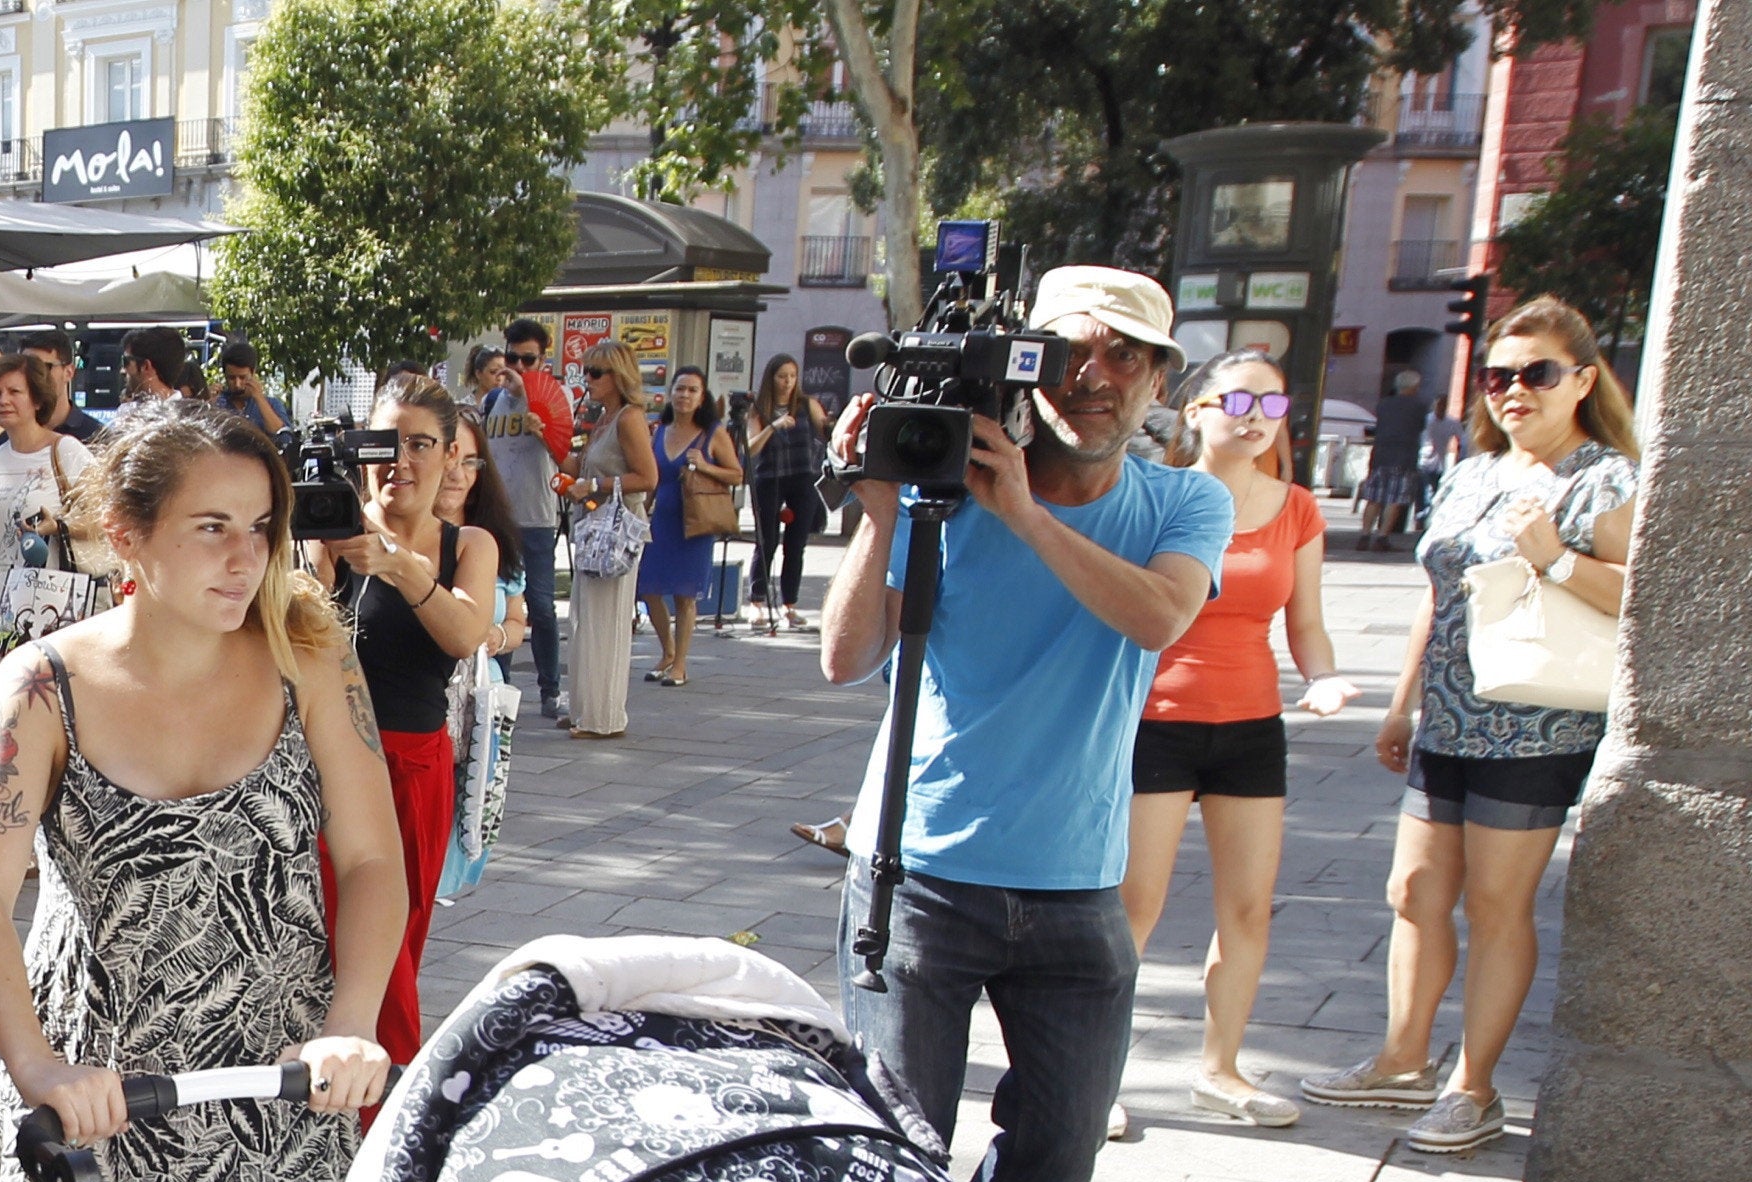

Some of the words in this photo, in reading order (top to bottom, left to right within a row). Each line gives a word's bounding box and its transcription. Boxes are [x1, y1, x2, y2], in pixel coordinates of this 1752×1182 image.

[1252, 283, 1284, 298] WC
[568, 318, 609, 330] MADRID
[852, 1147, 890, 1174] milk
